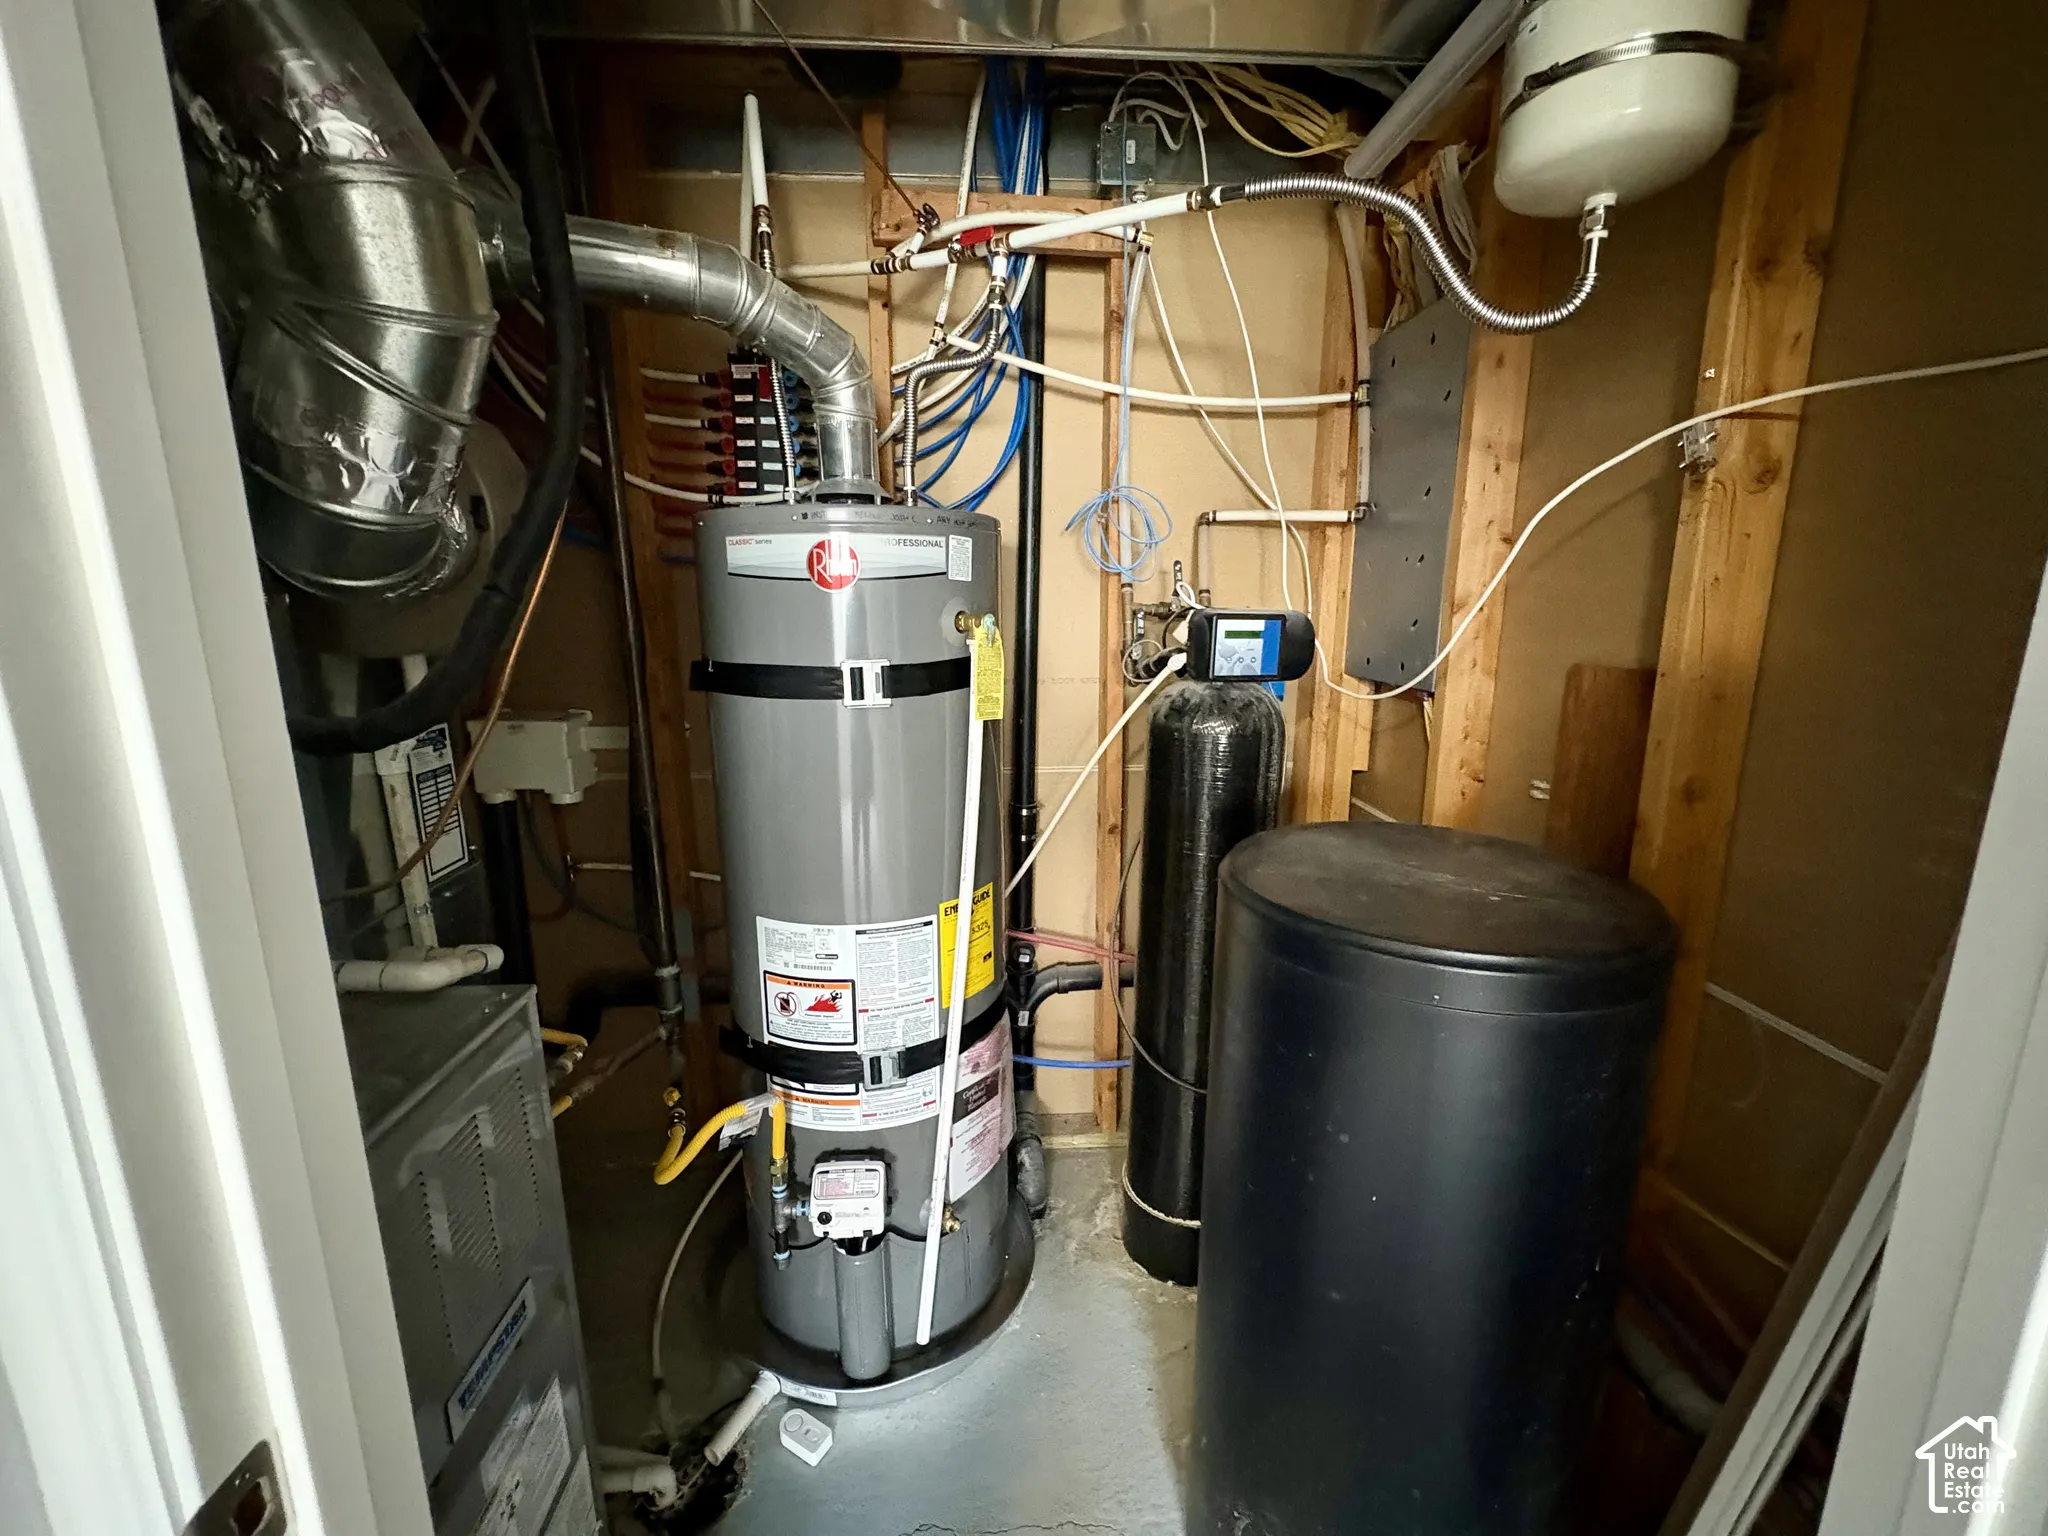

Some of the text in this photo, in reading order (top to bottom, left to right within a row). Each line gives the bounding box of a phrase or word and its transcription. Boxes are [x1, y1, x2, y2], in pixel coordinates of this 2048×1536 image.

[882, 538, 944, 548] ROFESSIONAL
[793, 981, 826, 989] WARNING
[802, 1097, 830, 1106] WARNING
